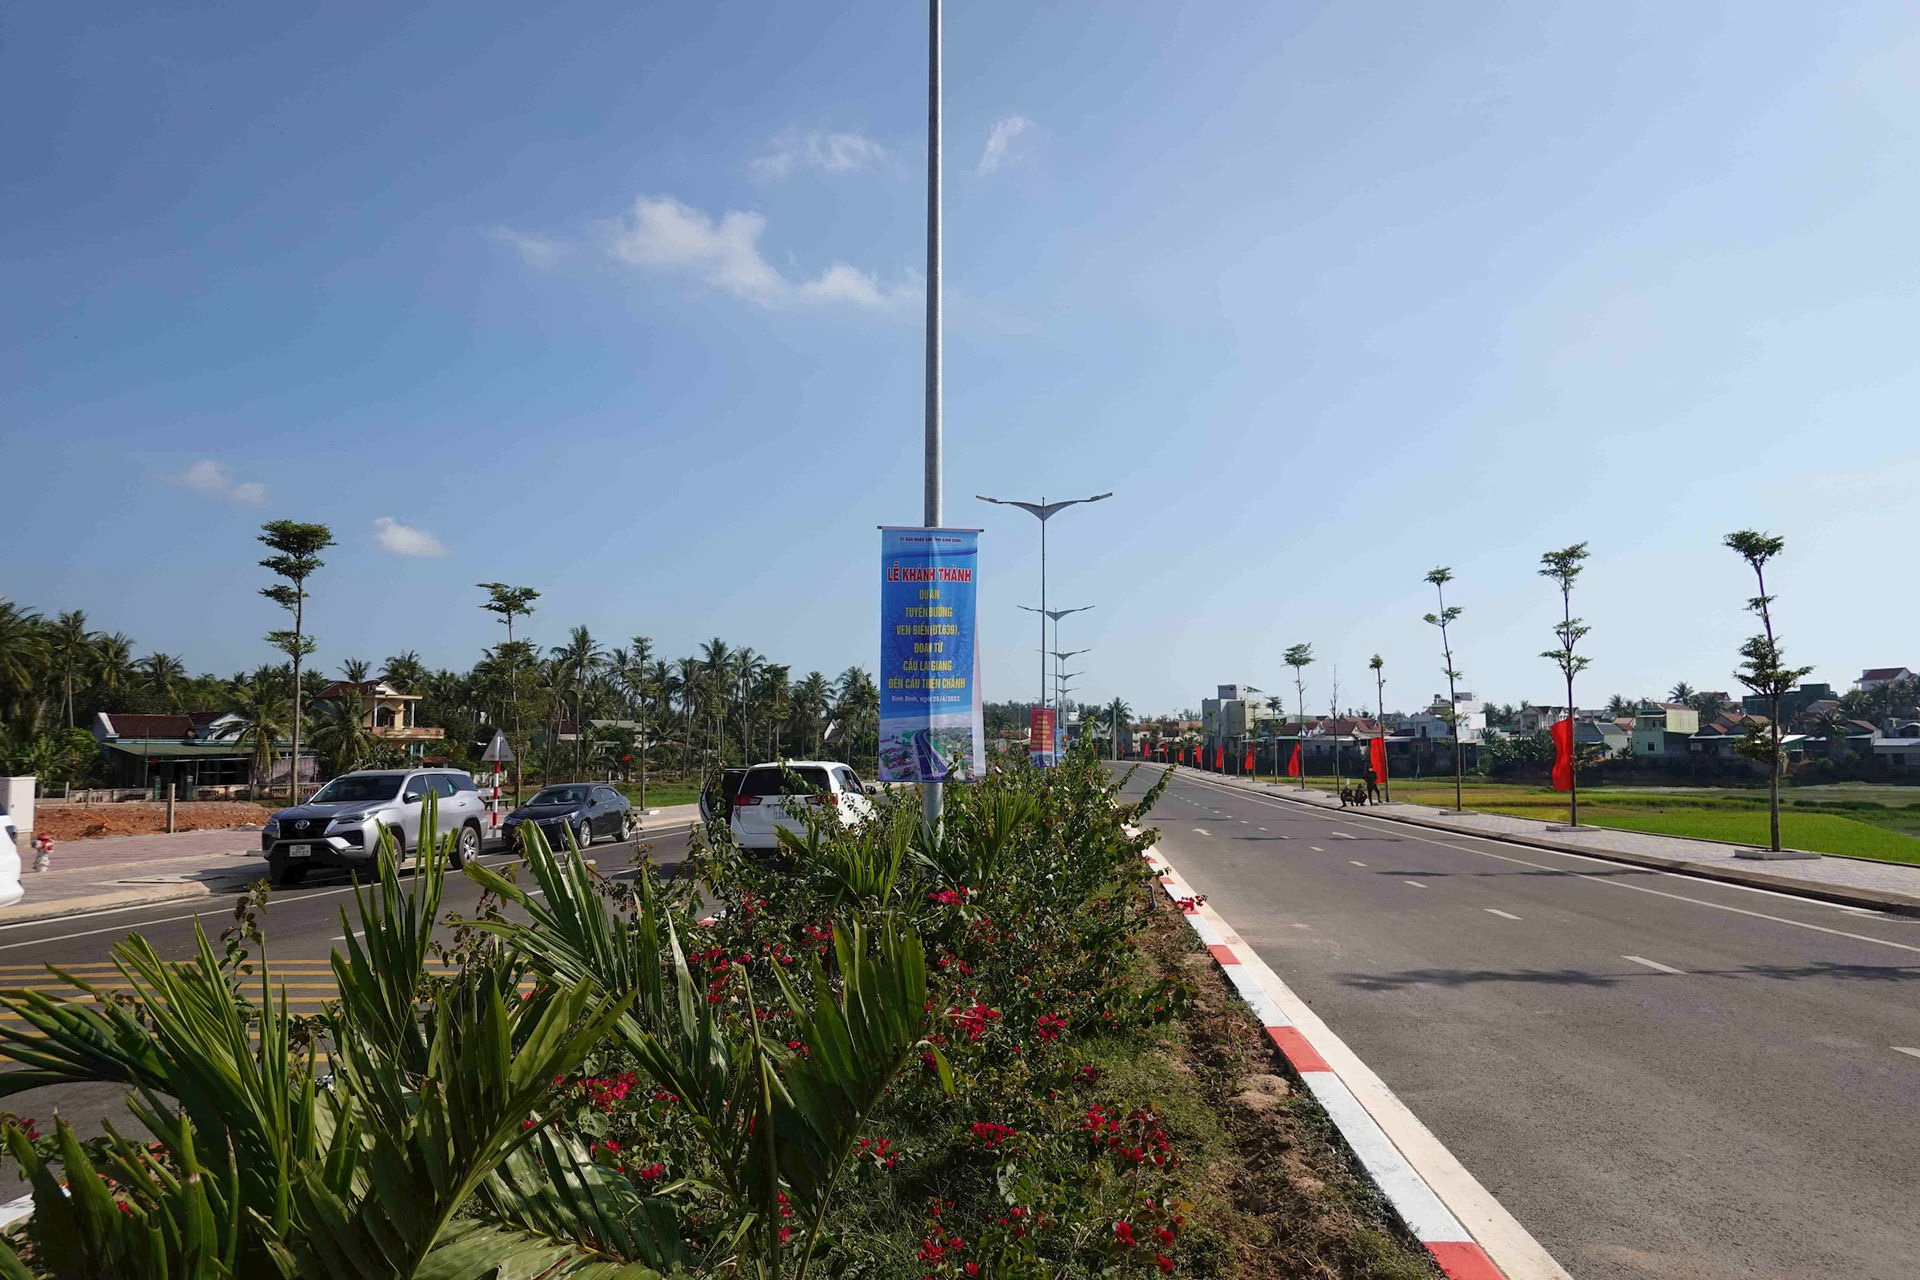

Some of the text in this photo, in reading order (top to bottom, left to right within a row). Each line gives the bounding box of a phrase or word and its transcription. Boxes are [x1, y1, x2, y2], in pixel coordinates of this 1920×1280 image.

[902, 564, 936, 582] KHÁNH
[897, 625, 910, 635] VEN
[931, 660, 952, 671] GIANG
